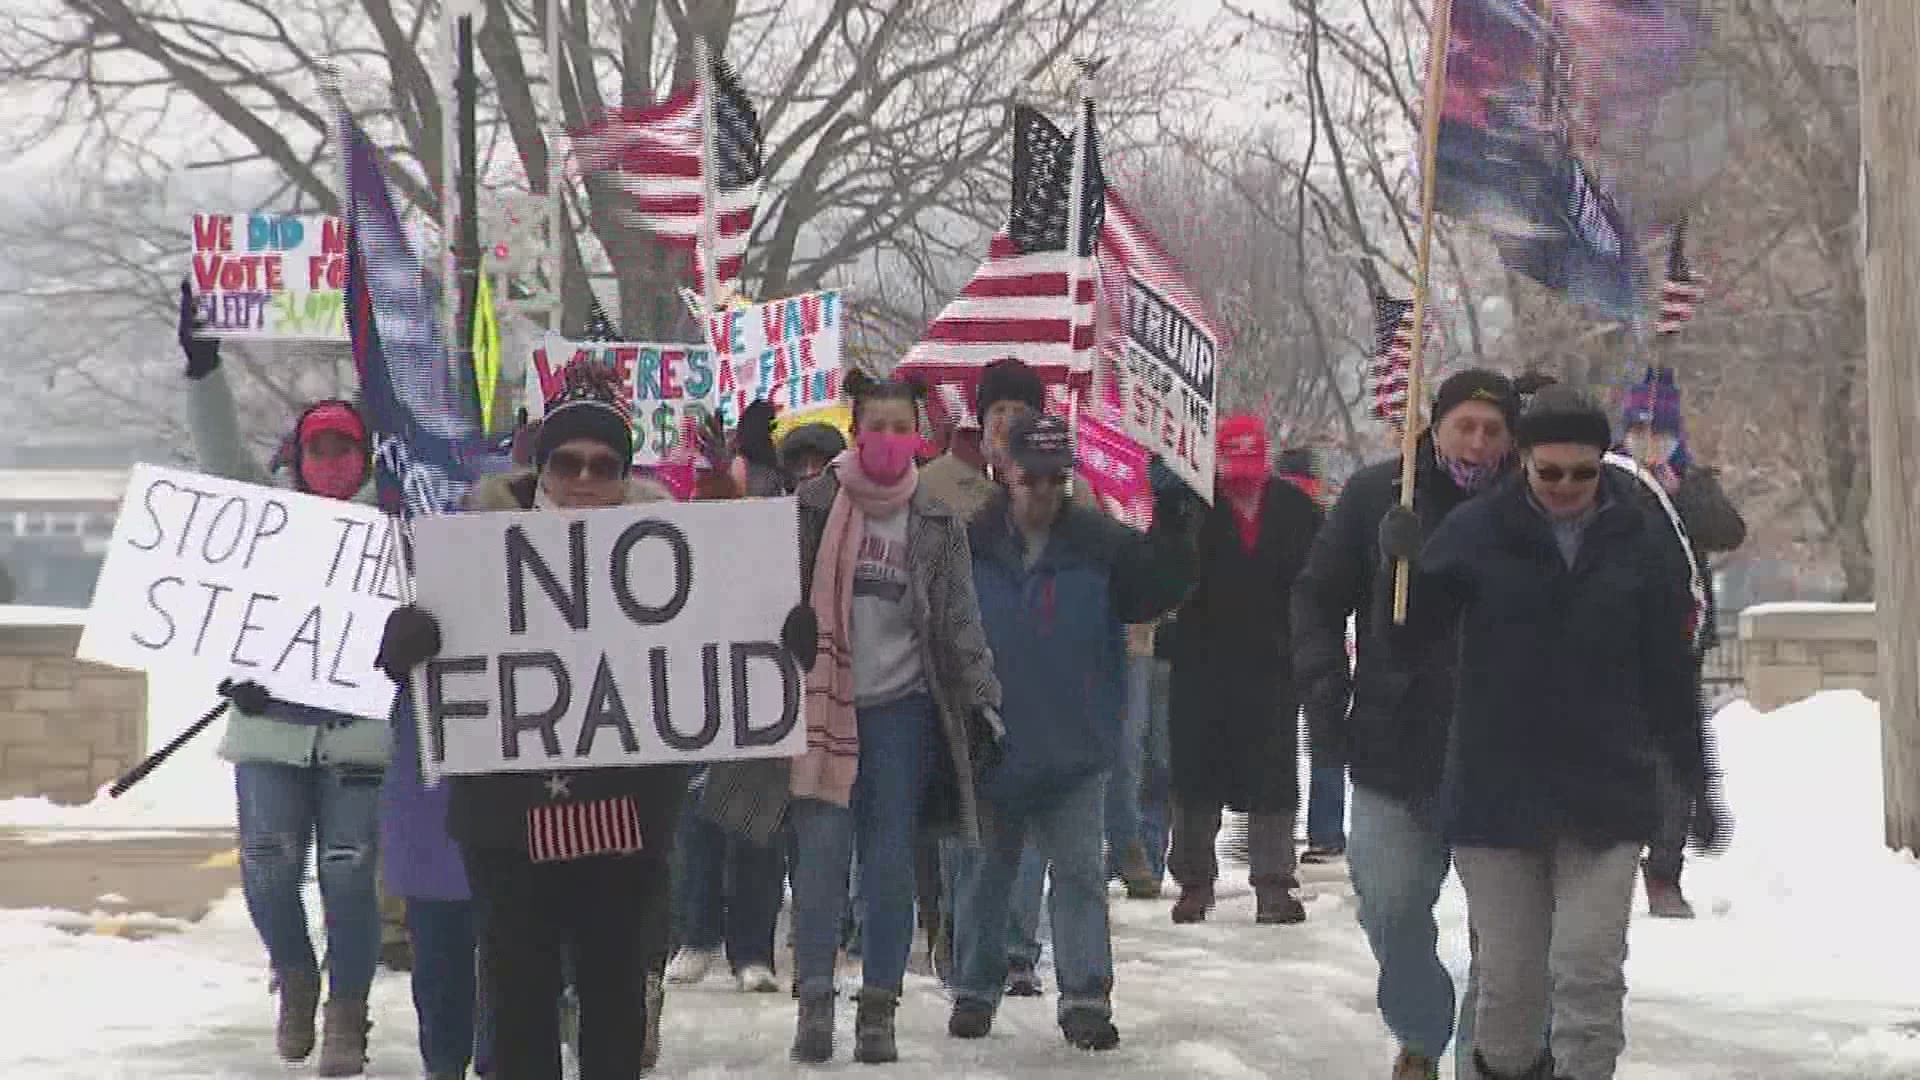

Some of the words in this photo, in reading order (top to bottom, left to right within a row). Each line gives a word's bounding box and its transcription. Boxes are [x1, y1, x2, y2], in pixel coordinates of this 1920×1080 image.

[193, 213, 233, 251] WE
[248, 213, 305, 251] DID
[193, 254, 283, 290] VOTE
[711, 311, 745, 357] WE
[762, 291, 837, 347] WANT
[1126, 287, 1213, 386] TRUMP
[718, 359, 735, 394] A
[1181, 387, 1210, 436] THE
[1132, 386, 1200, 473] STEAL
[128, 478, 290, 569] STOP
[503, 518, 694, 635] NO
[130, 576, 359, 688] STEAL
[426, 640, 800, 762] FRAUD
